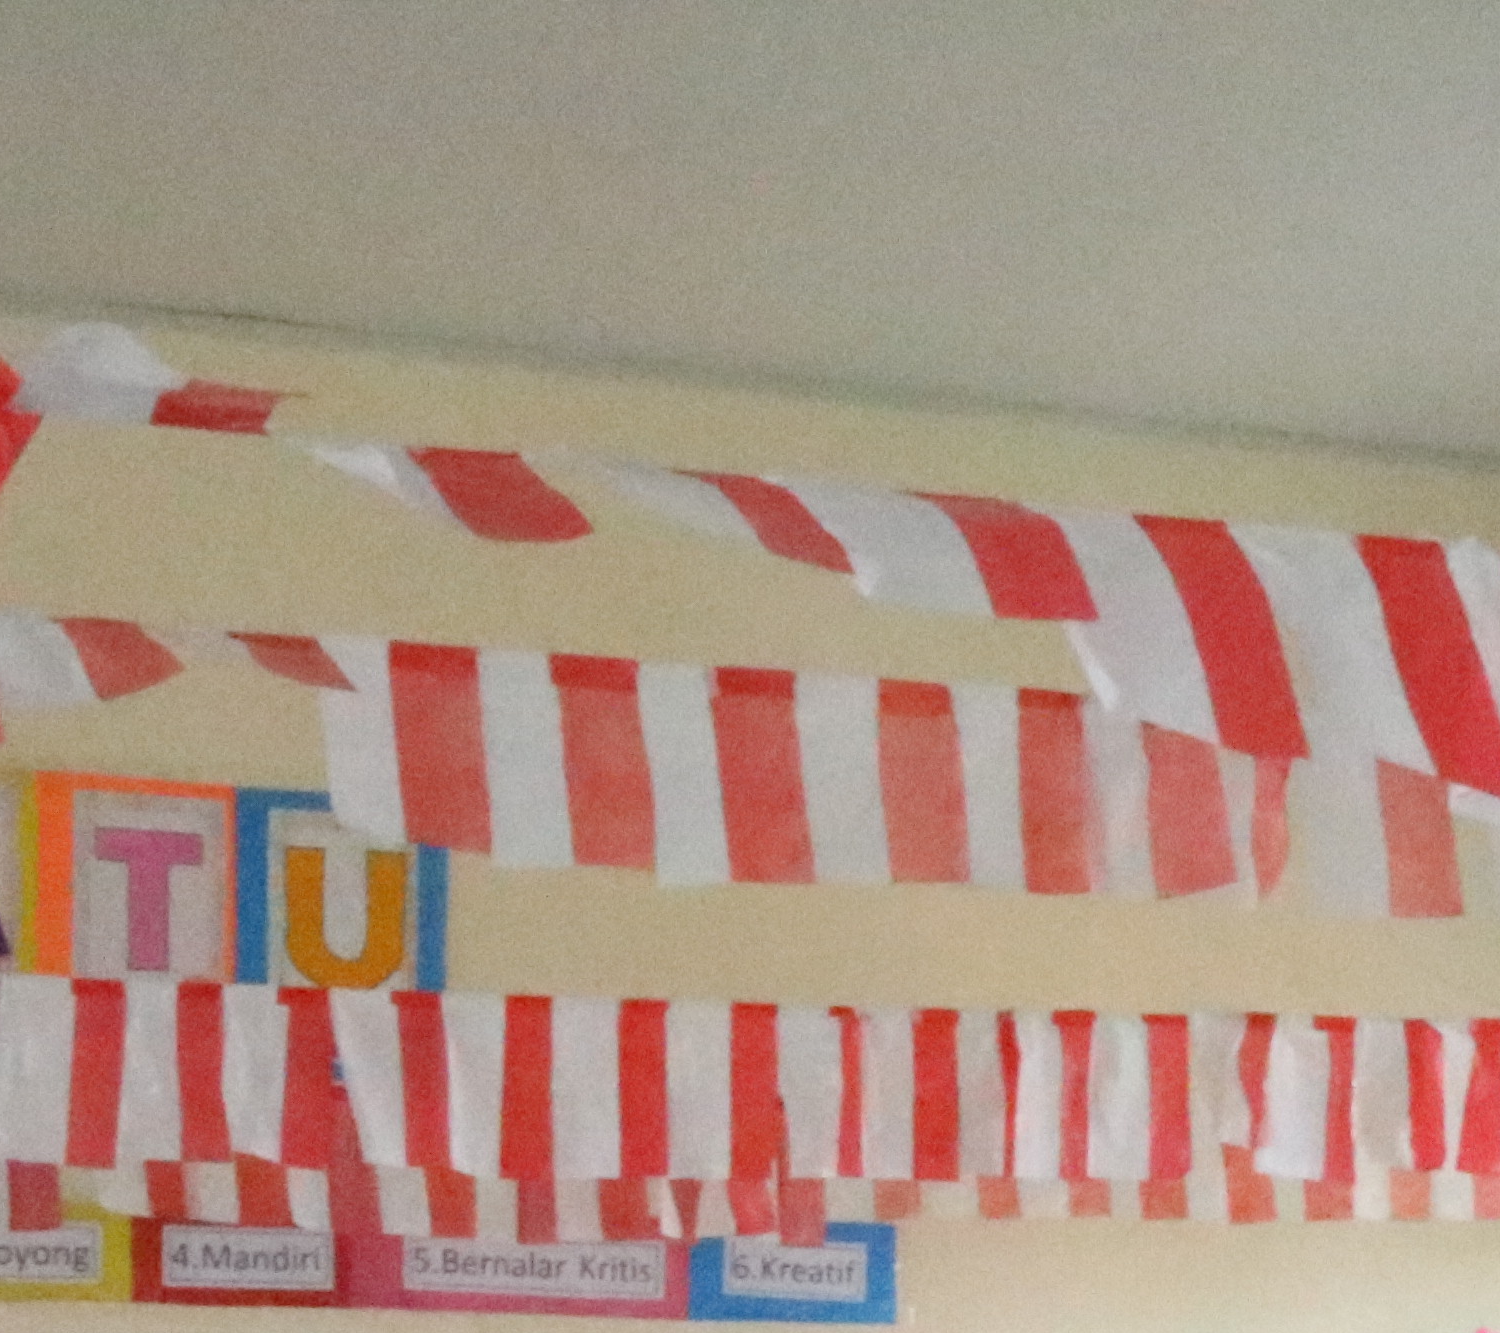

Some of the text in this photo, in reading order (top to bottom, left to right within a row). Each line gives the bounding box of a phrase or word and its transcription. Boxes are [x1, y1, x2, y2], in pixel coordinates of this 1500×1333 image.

[170, 1242, 322, 1273] 4.Mandiri
[413, 1247, 653, 1284] 5.Bernalar Kritis
[731, 1257, 859, 1286] 6.Kreatif
